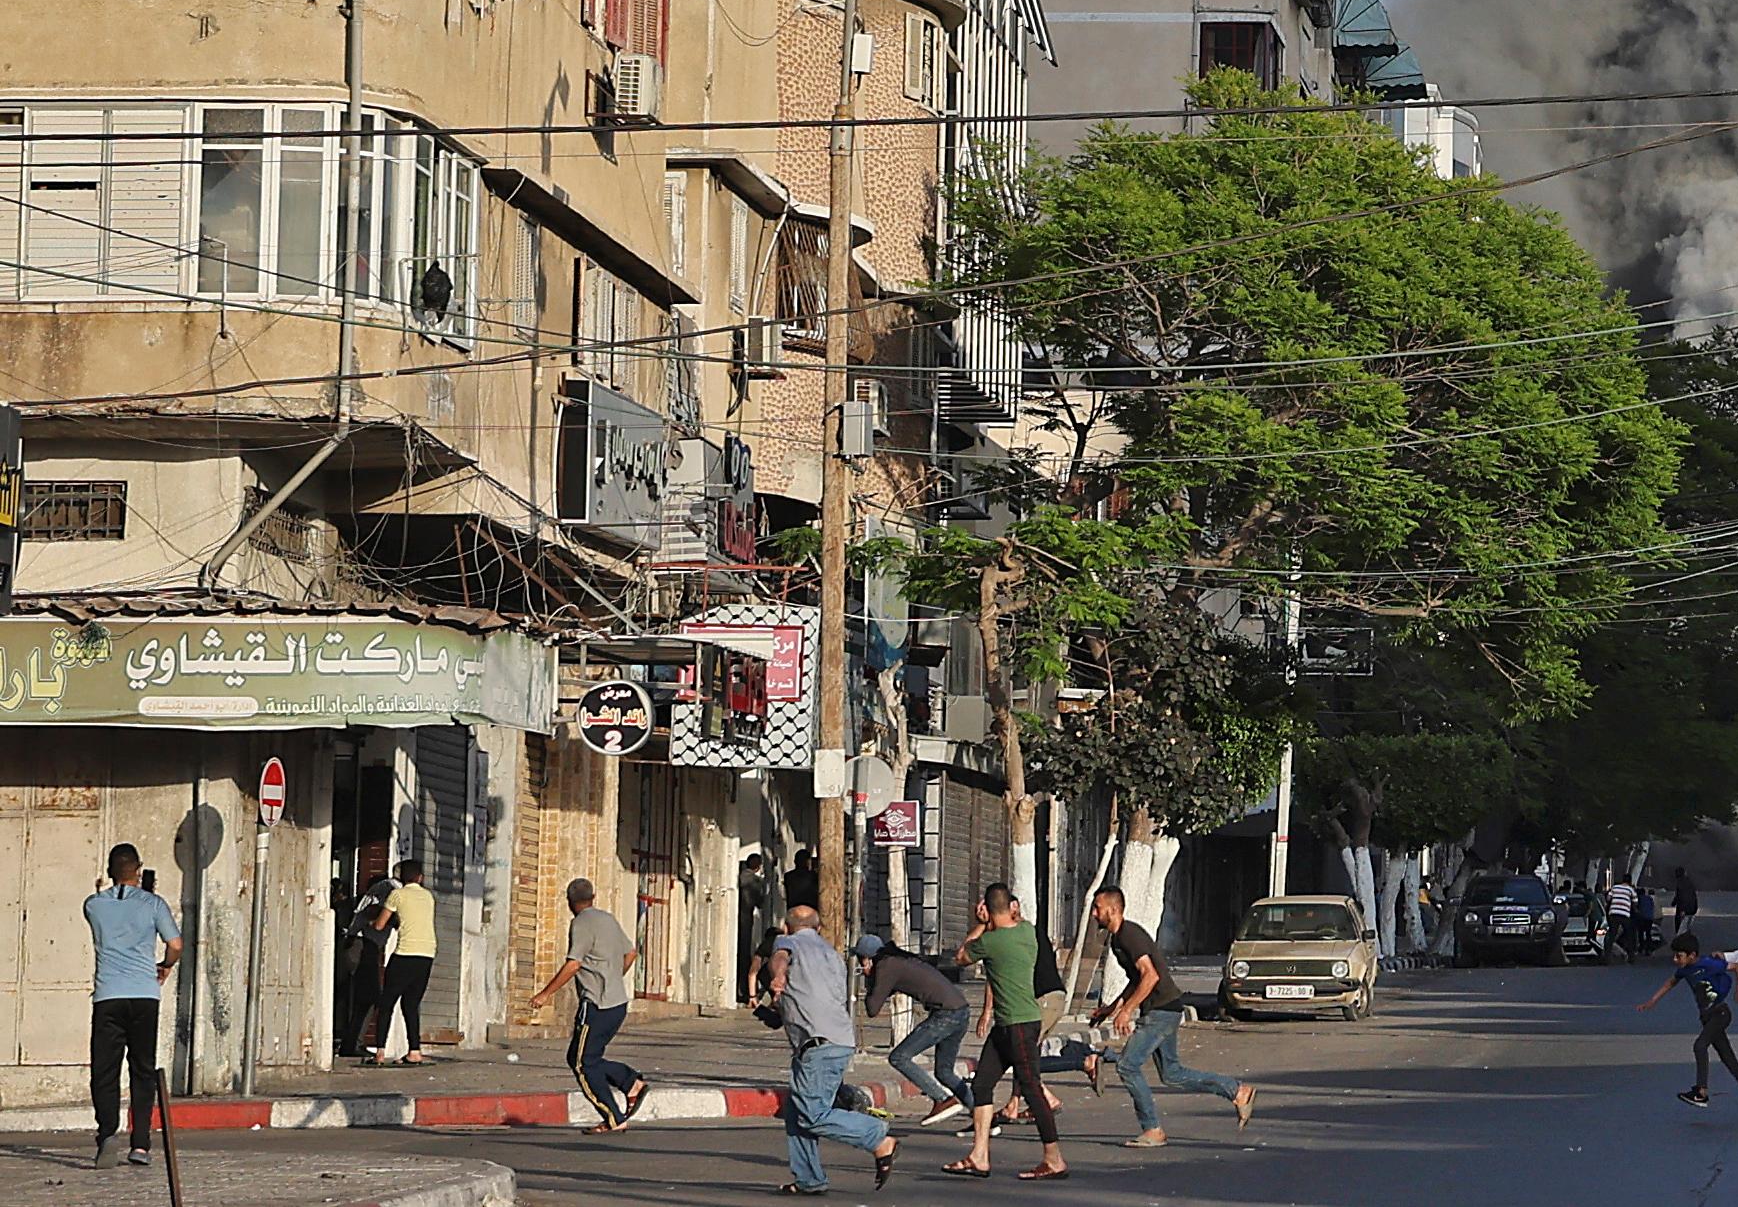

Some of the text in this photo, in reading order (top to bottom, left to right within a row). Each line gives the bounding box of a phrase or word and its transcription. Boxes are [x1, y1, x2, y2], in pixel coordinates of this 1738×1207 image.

[125, 627, 307, 690] القيشاوي
[315, 632, 449, 683] ماركت
[266, 695, 325, 714] التموينية
[328, 695, 374, 714] والمواد
[600, 686, 632, 701] معرض
[580, 704, 621, 728] الشوا
[604, 730, 623, 752] 2
